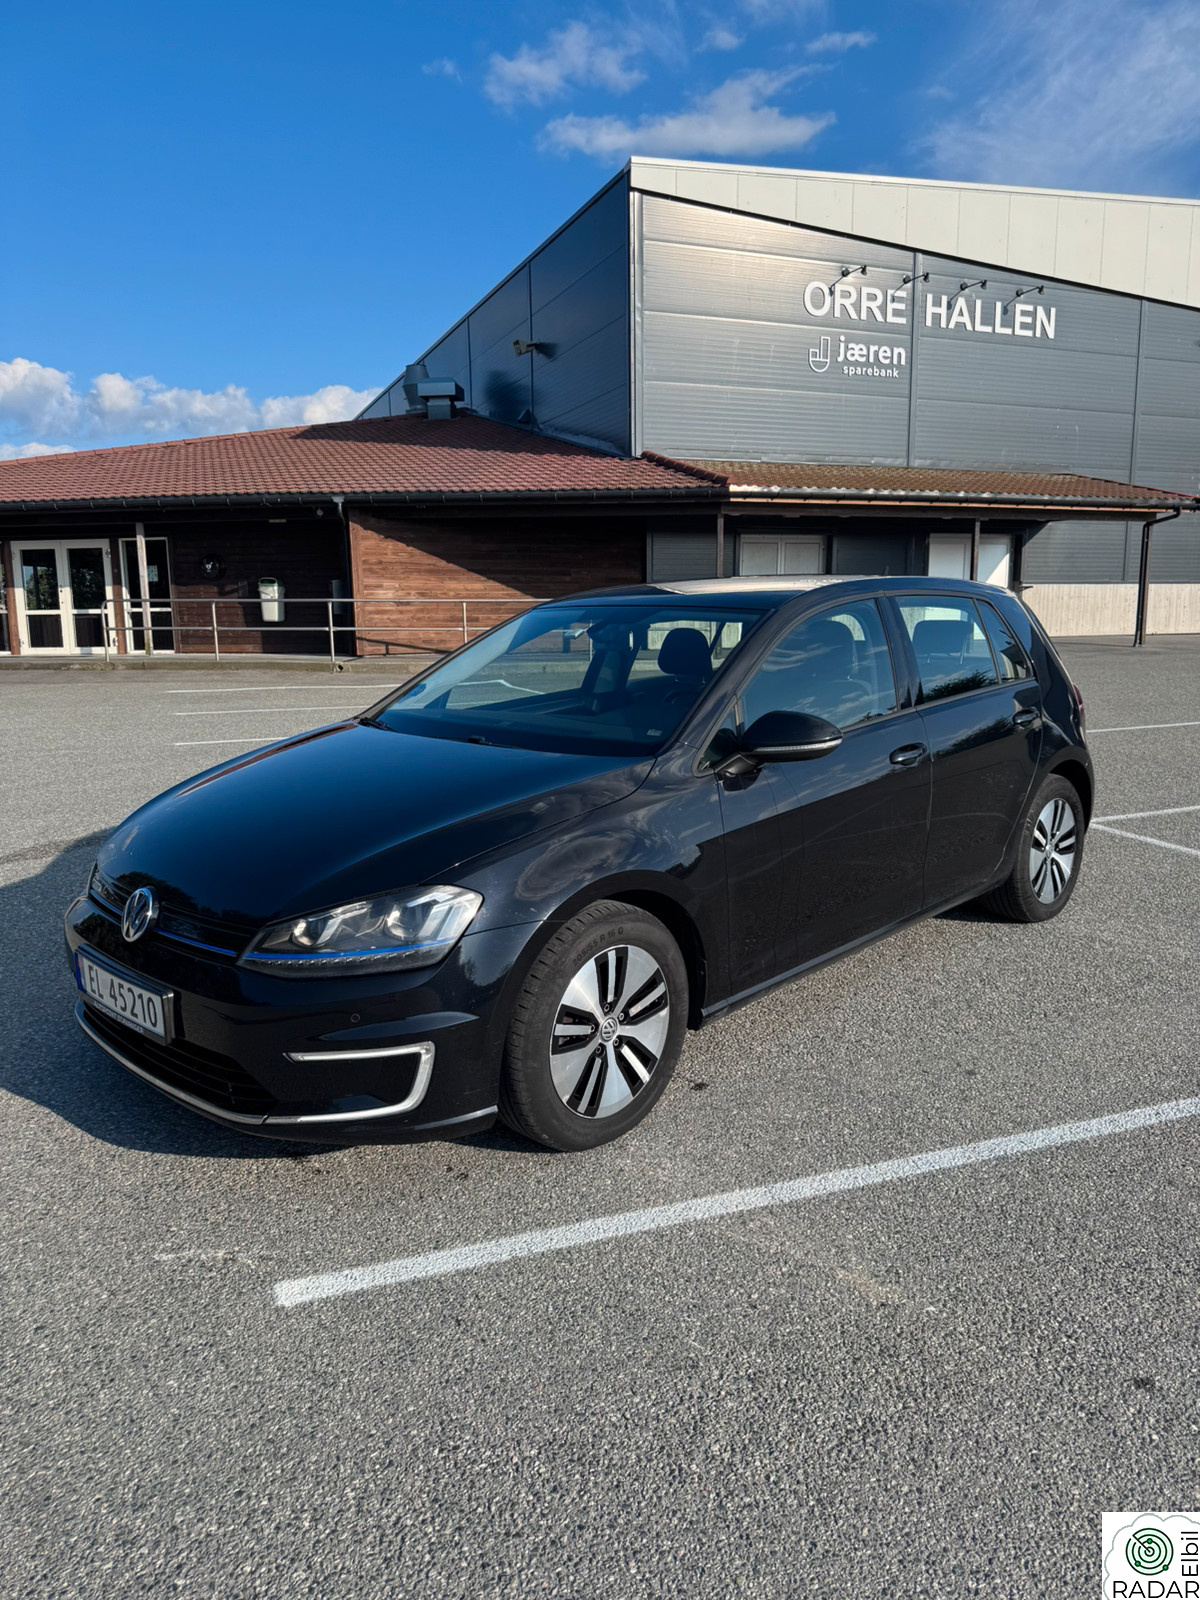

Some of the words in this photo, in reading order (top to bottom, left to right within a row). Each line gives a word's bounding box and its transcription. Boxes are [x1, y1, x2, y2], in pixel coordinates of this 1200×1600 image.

[803, 281, 907, 325] ORRE
[925, 293, 1056, 339] HALLEN
[837, 335, 906, 366] jæren
[843, 365, 899, 378] sparebank
[88, 964, 104, 1000] EL
[109, 978, 158, 1028] 45210
